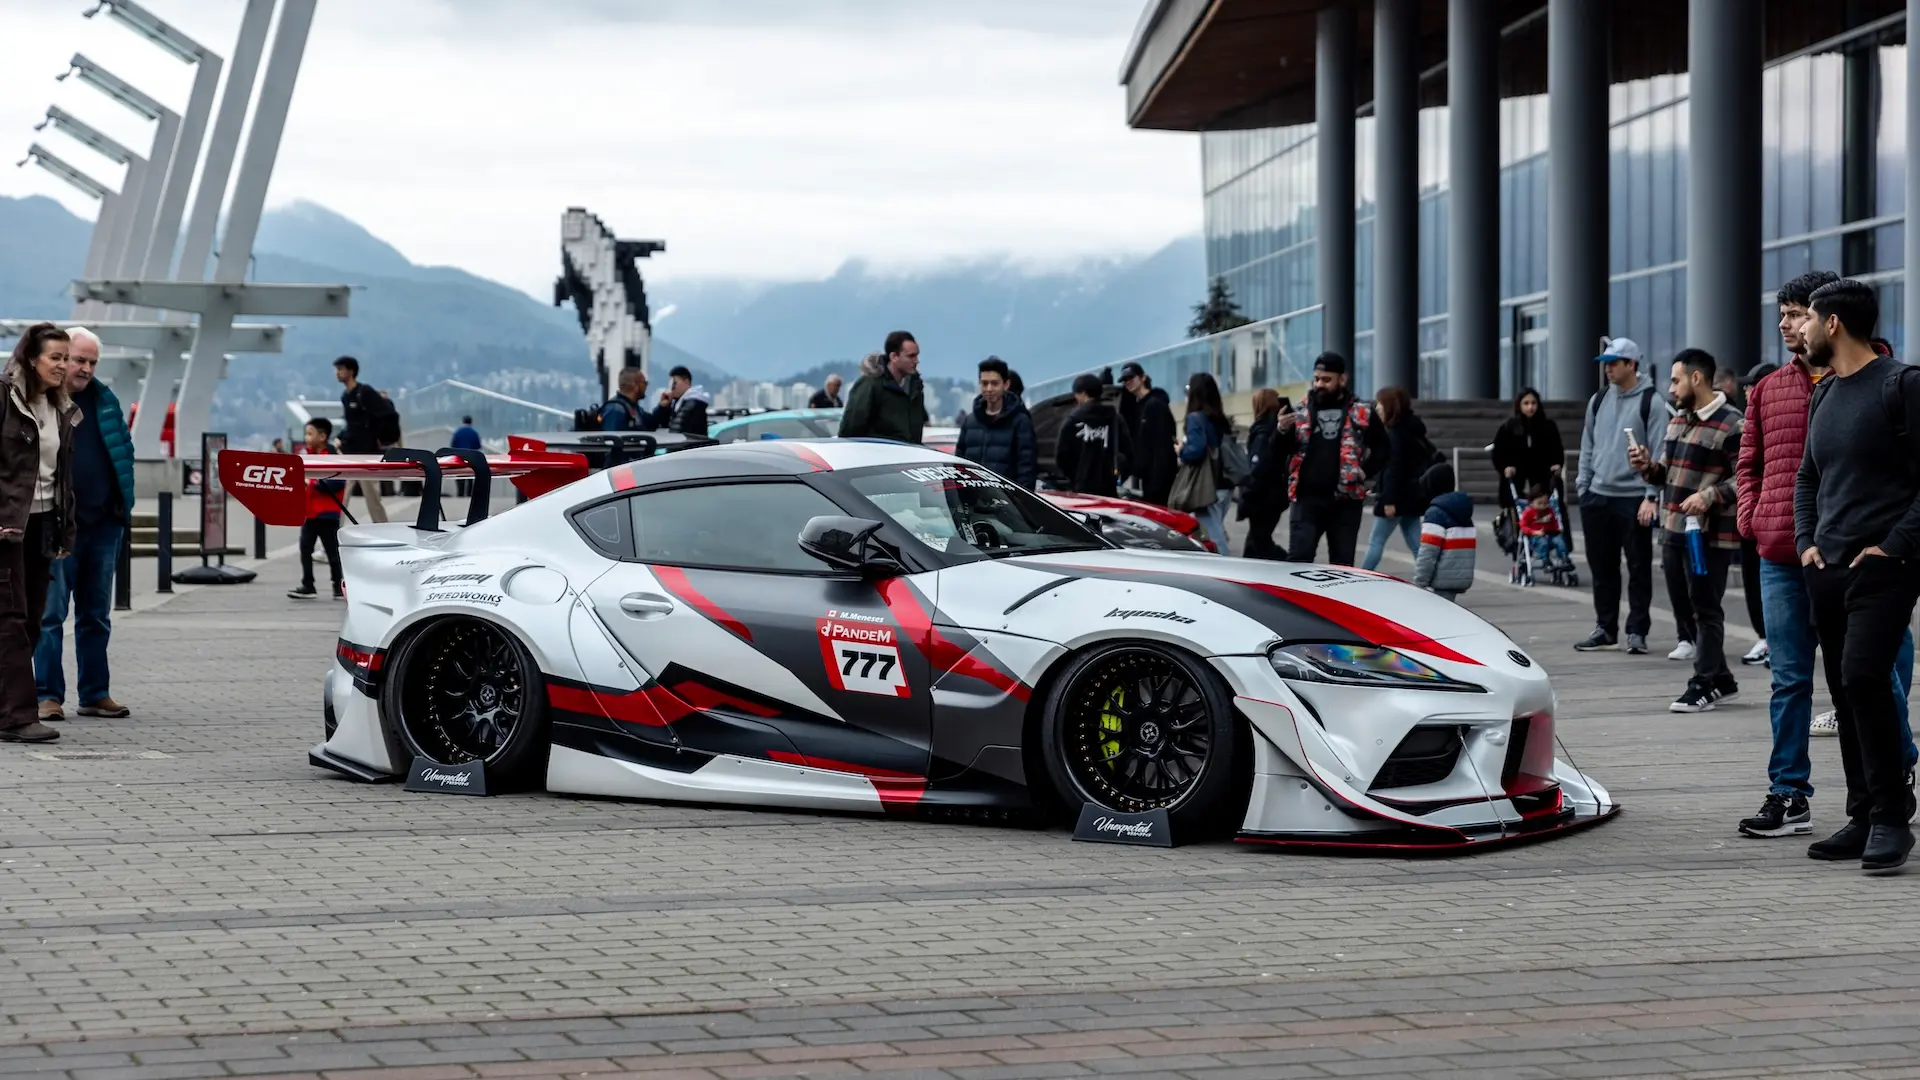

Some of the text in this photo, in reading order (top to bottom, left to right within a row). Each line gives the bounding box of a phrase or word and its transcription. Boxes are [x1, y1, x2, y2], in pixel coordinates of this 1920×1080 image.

[243, 465, 286, 485] GR
[426, 591, 504, 603] SPEEDWORKS
[842, 649, 896, 680] 777
[421, 768, 471, 786] Unexpected
[1093, 816, 1153, 837] Unexpected
